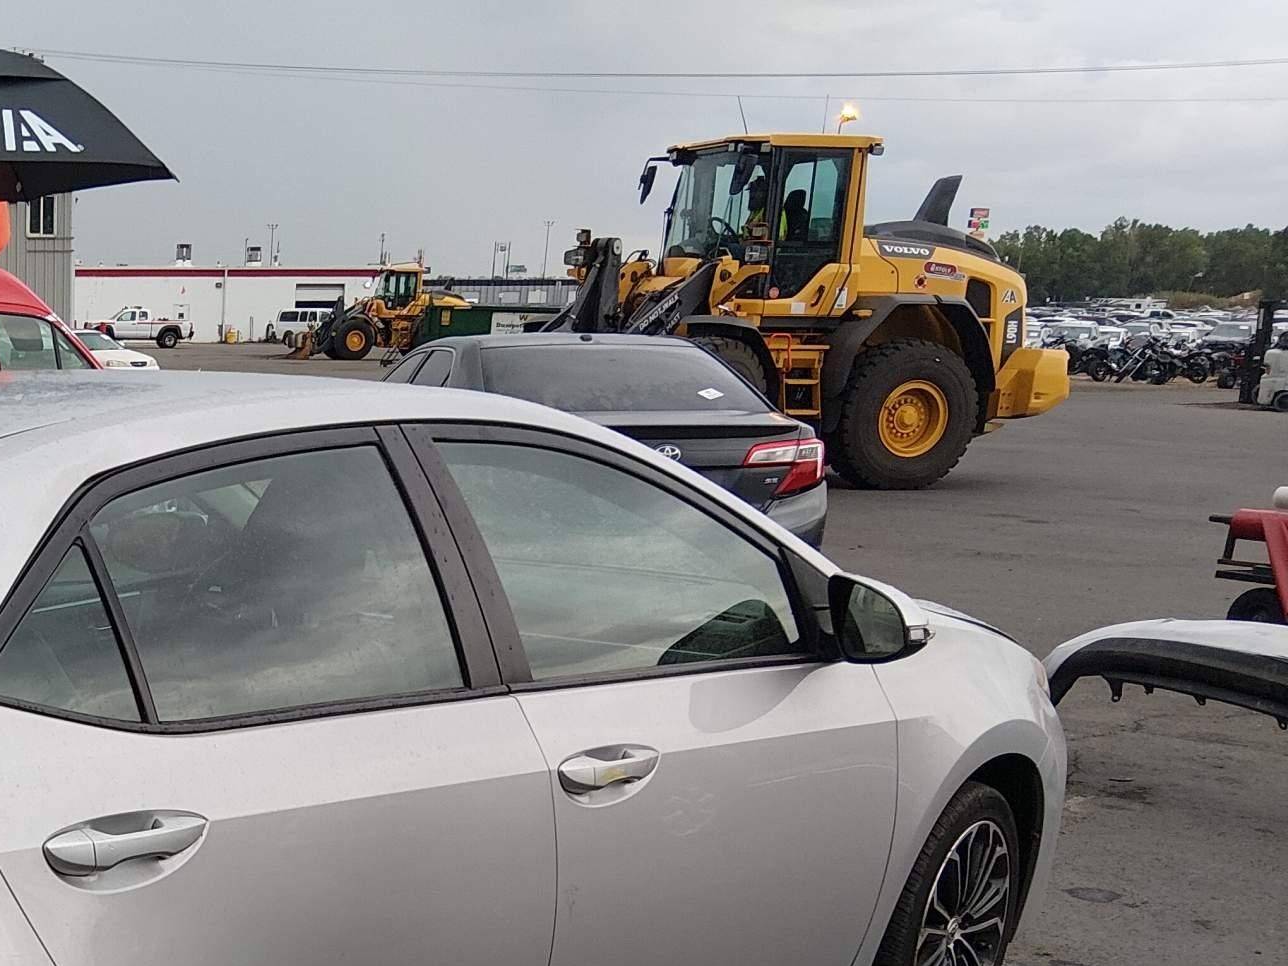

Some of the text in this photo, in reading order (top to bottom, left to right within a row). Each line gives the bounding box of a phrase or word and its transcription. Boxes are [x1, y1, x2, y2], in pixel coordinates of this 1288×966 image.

[882, 244, 930, 256] VOLVO
[639, 319, 649, 331] DO
[661, 293, 680, 313] WALK
[1006, 320, 1019, 344] L90H
